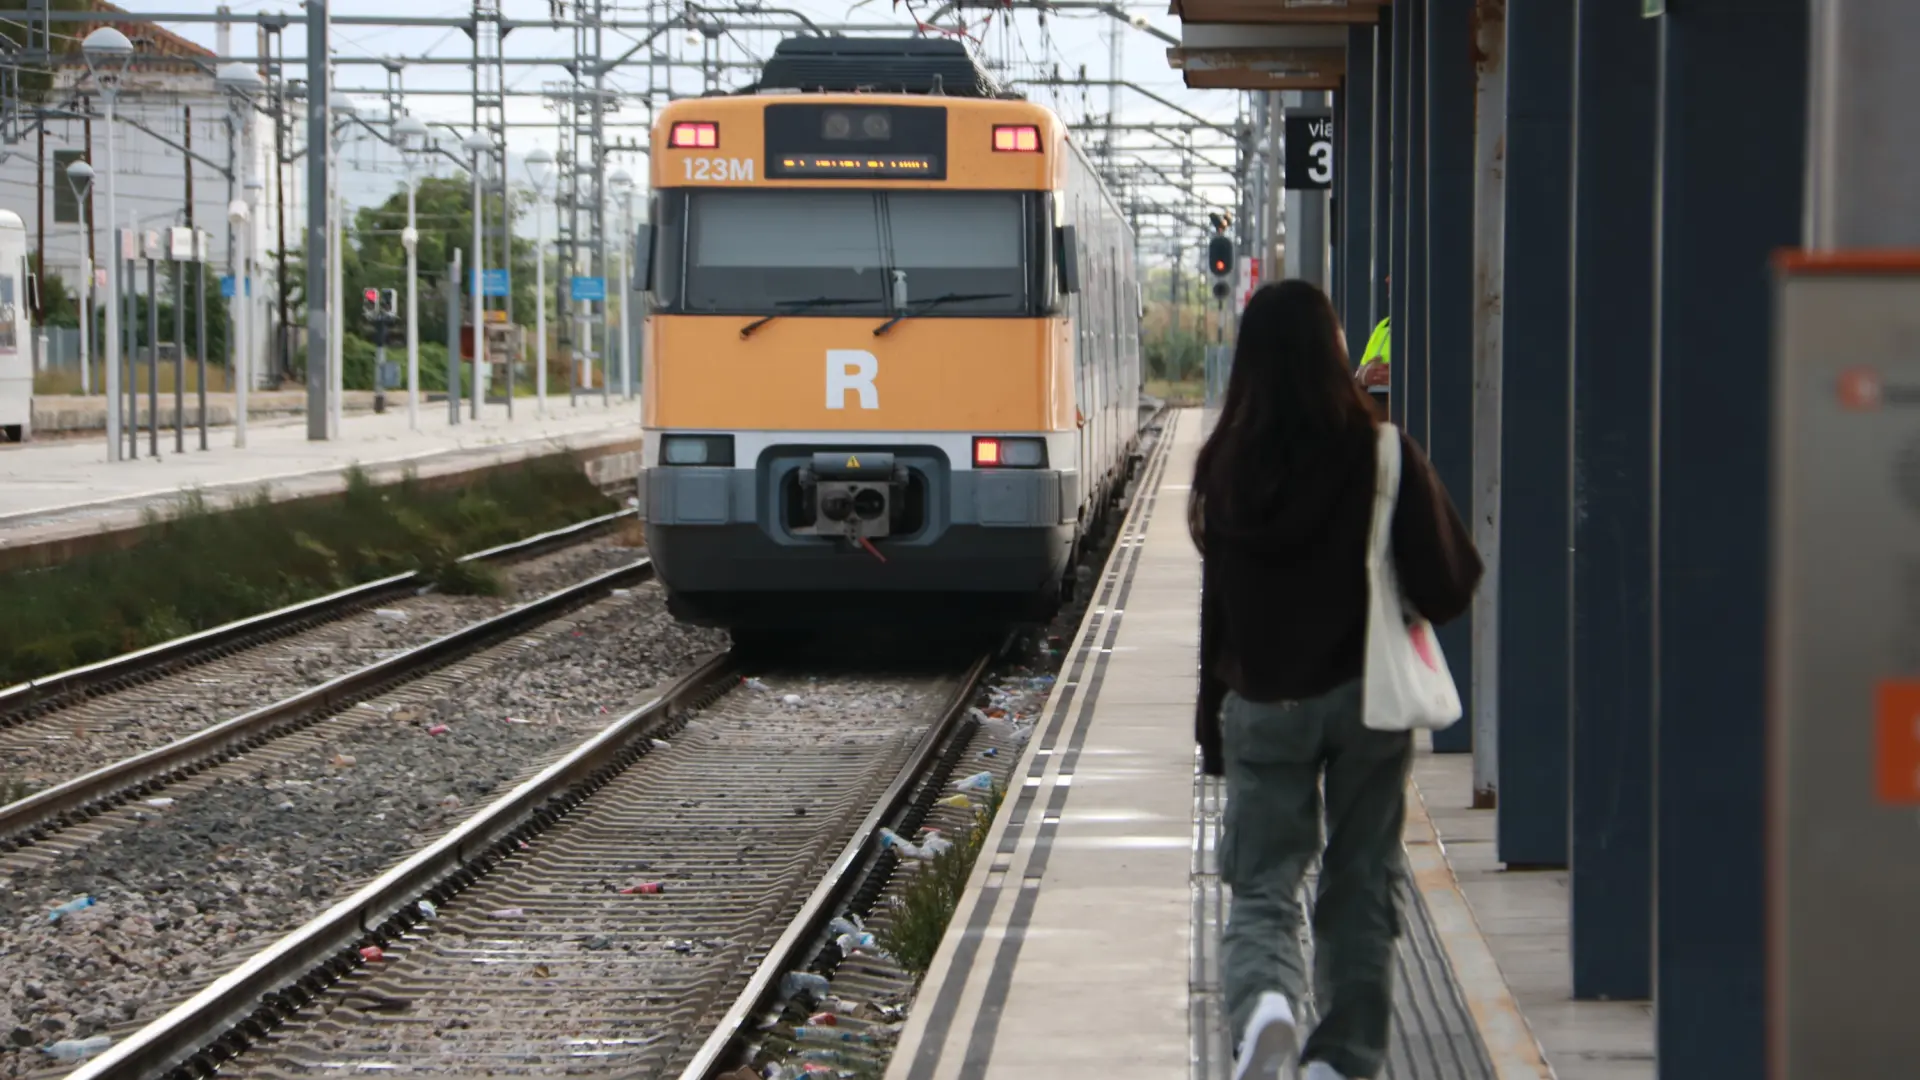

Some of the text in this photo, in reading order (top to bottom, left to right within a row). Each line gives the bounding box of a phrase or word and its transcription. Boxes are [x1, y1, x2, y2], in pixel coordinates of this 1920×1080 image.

[683, 157, 754, 181] 123M
[1308, 141, 1333, 184] 3
[825, 348, 880, 410] R
